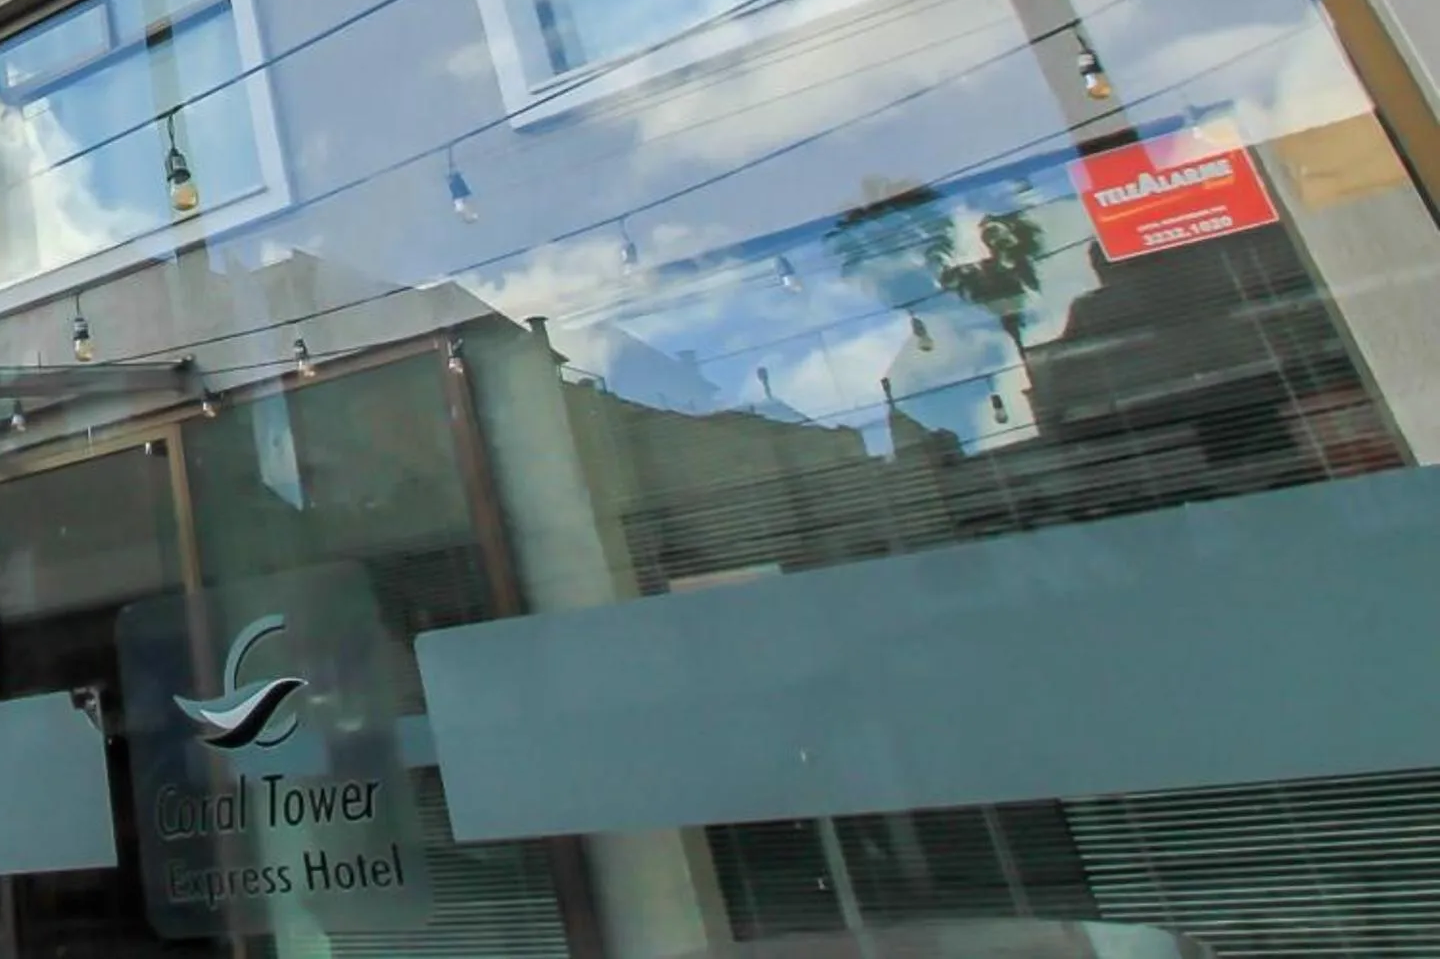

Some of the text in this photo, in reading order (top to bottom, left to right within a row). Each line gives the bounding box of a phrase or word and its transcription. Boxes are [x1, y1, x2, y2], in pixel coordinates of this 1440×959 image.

[156, 774, 380, 838] Coral Tower
[169, 844, 404, 909] Express Hotel
